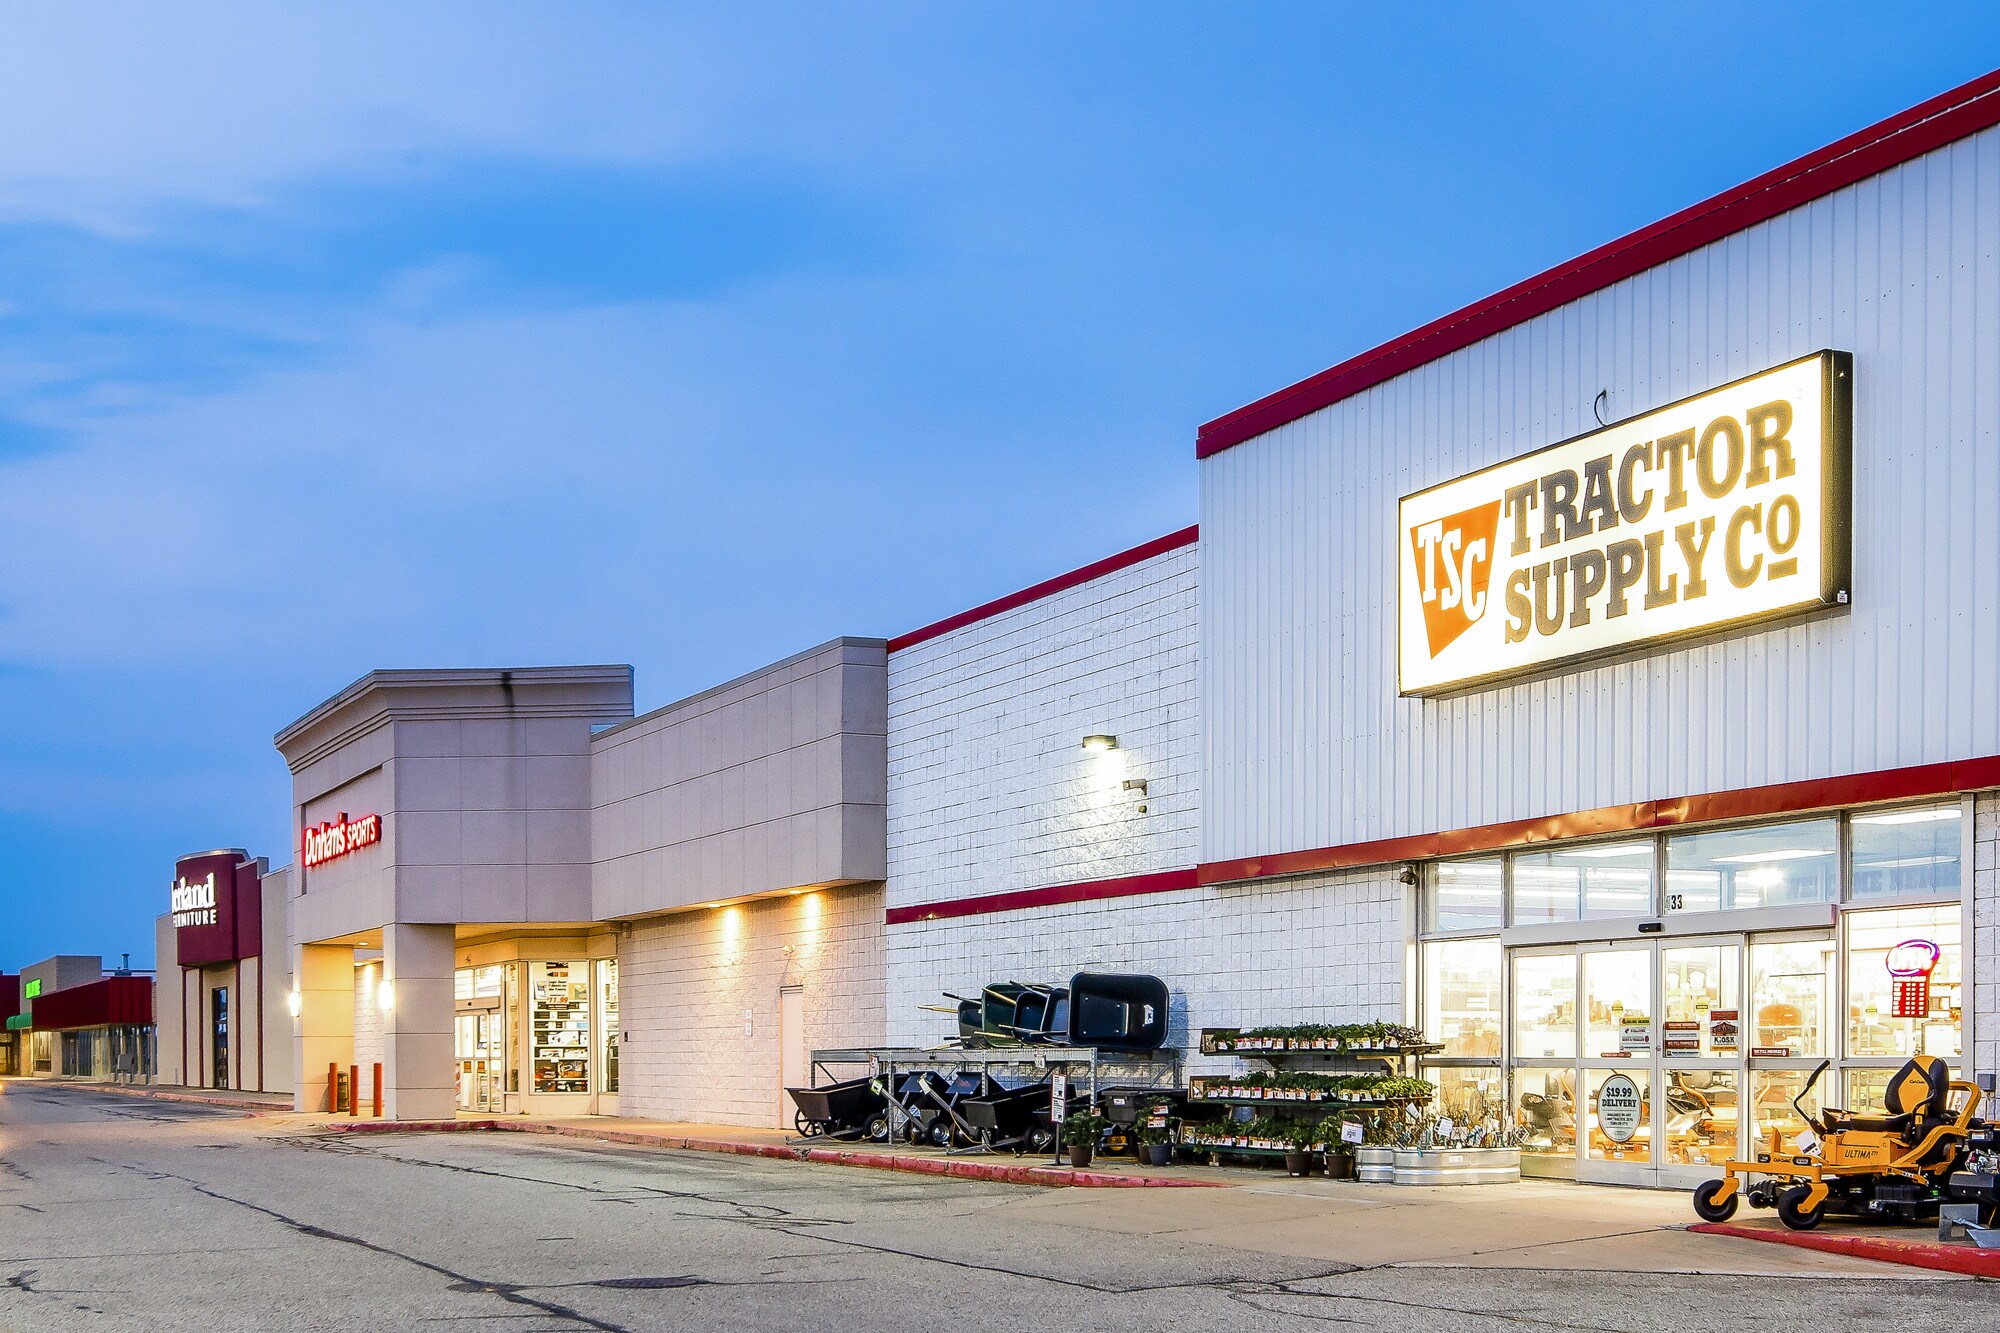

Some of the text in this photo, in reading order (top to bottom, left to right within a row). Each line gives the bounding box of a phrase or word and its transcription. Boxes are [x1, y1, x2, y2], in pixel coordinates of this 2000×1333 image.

[1505, 399, 1795, 557] TRACTOR
[1417, 520, 1487, 622] TSC
[1505, 516, 1716, 644] SUPPLY
[305, 812, 376, 866] Dunham's SPORTS
[1602, 1099, 1637, 1108] DELIVERY
[1606, 1086, 1633, 1098] $19.99
[1845, 1149, 1871, 1159] ULTIMA
